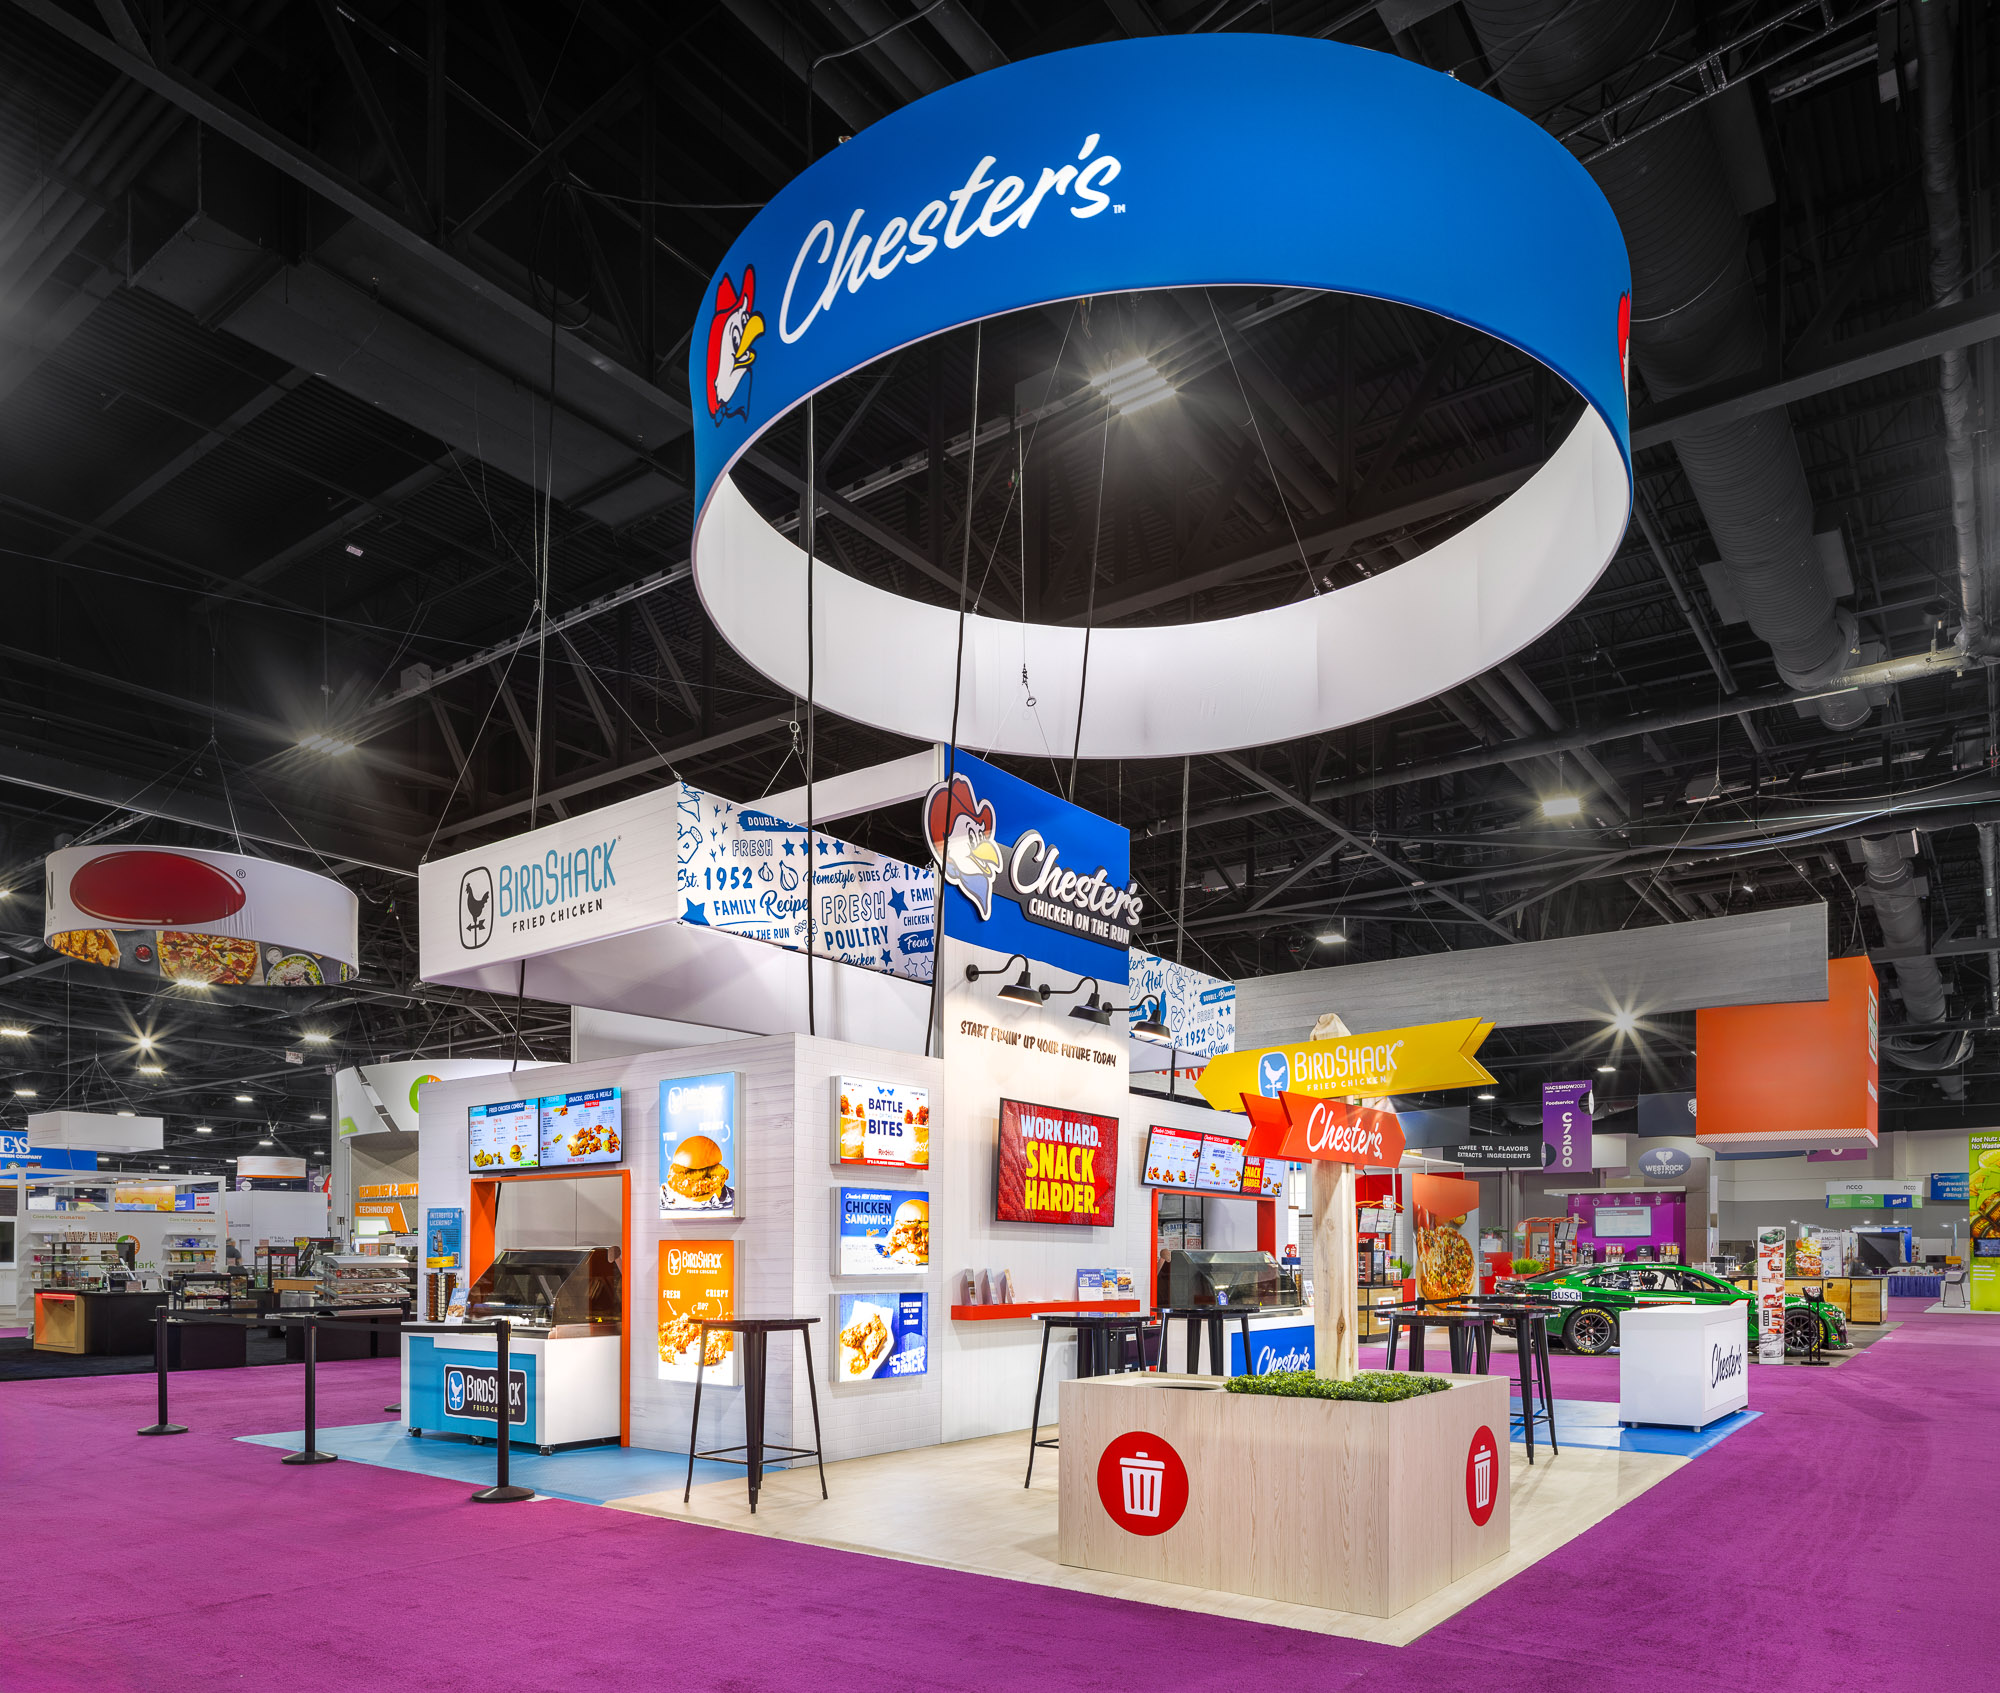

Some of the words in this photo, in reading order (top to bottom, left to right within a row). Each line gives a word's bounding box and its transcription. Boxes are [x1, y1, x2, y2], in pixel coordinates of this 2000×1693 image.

[779, 133, 1122, 345] Chester's
[732, 839, 773, 857] FRESH
[704, 867, 753, 891] 1952
[859, 870, 880, 883] SIDES
[883, 862, 901, 882] Est.
[1011, 830, 1143, 927] Chester's
[714, 898, 756, 916] FAMILY
[759, 889, 809, 920] Recipe
[821, 890, 886, 925] FRESH
[512, 914, 546, 933] FRIED
[550, 898, 603, 923] CHICKEN
[903, 914, 930, 927] CHICKEN
[1028, 898, 1074, 927] CHICKEN
[1074, 912, 1090, 931] ON
[1090, 918, 1109, 938] THE
[1109, 923, 1130, 944] RUN
[756, 929, 771, 940] THE
[774, 928, 790, 939] RUN
[824, 925, 889, 951] POULTRY
[904, 934, 930, 951] Focus
[1141, 970, 1163, 994] Hot
[960, 1020, 989, 1039] START
[1023, 1034, 1036, 1050] UP
[1036, 1037, 1059, 1055] YOUR
[1061, 1043, 1091, 1062] FUTURE
[1092, 1050, 1117, 1067] TODAY
[1185, 1028, 1206, 1047] 1952
[1306, 1082, 1336, 1092] FRIED
[1340, 1075, 1387, 1088] CHICKEN
[868, 1097, 903, 1114] BATTLE
[868, 1118, 903, 1138] BITES
[1020, 1113, 1063, 1143] WORK
[1064, 1120, 1102, 1148] HARD.
[1306, 1102, 1383, 1159] Chester's
[1025, 1140, 1096, 1184] SNACK
[1244, 1165, 1262, 1179] SNACK
[1645, 1164, 1684, 1172] WESTROCK
[1024, 1179, 1100, 1214] HARDER.
[358, 1205, 395, 1214] TECHNOLOGY
[845, 1200, 892, 1215] CHICKEN
[845, 1213, 892, 1225] SANDWICH
[663, 1289, 681, 1299] FRESH
[705, 1288, 729, 1298] CRISPY
[1551, 1291, 1582, 1300] BUSCH
[1256, 1345, 1311, 1377] Chester's
[1711, 1343, 1742, 1389] Chester's
[466, 1375, 522, 1406] BIRDSCK
[472, 1404, 490, 1413] FRIED
[490, 1406, 516, 1415] CHEN
